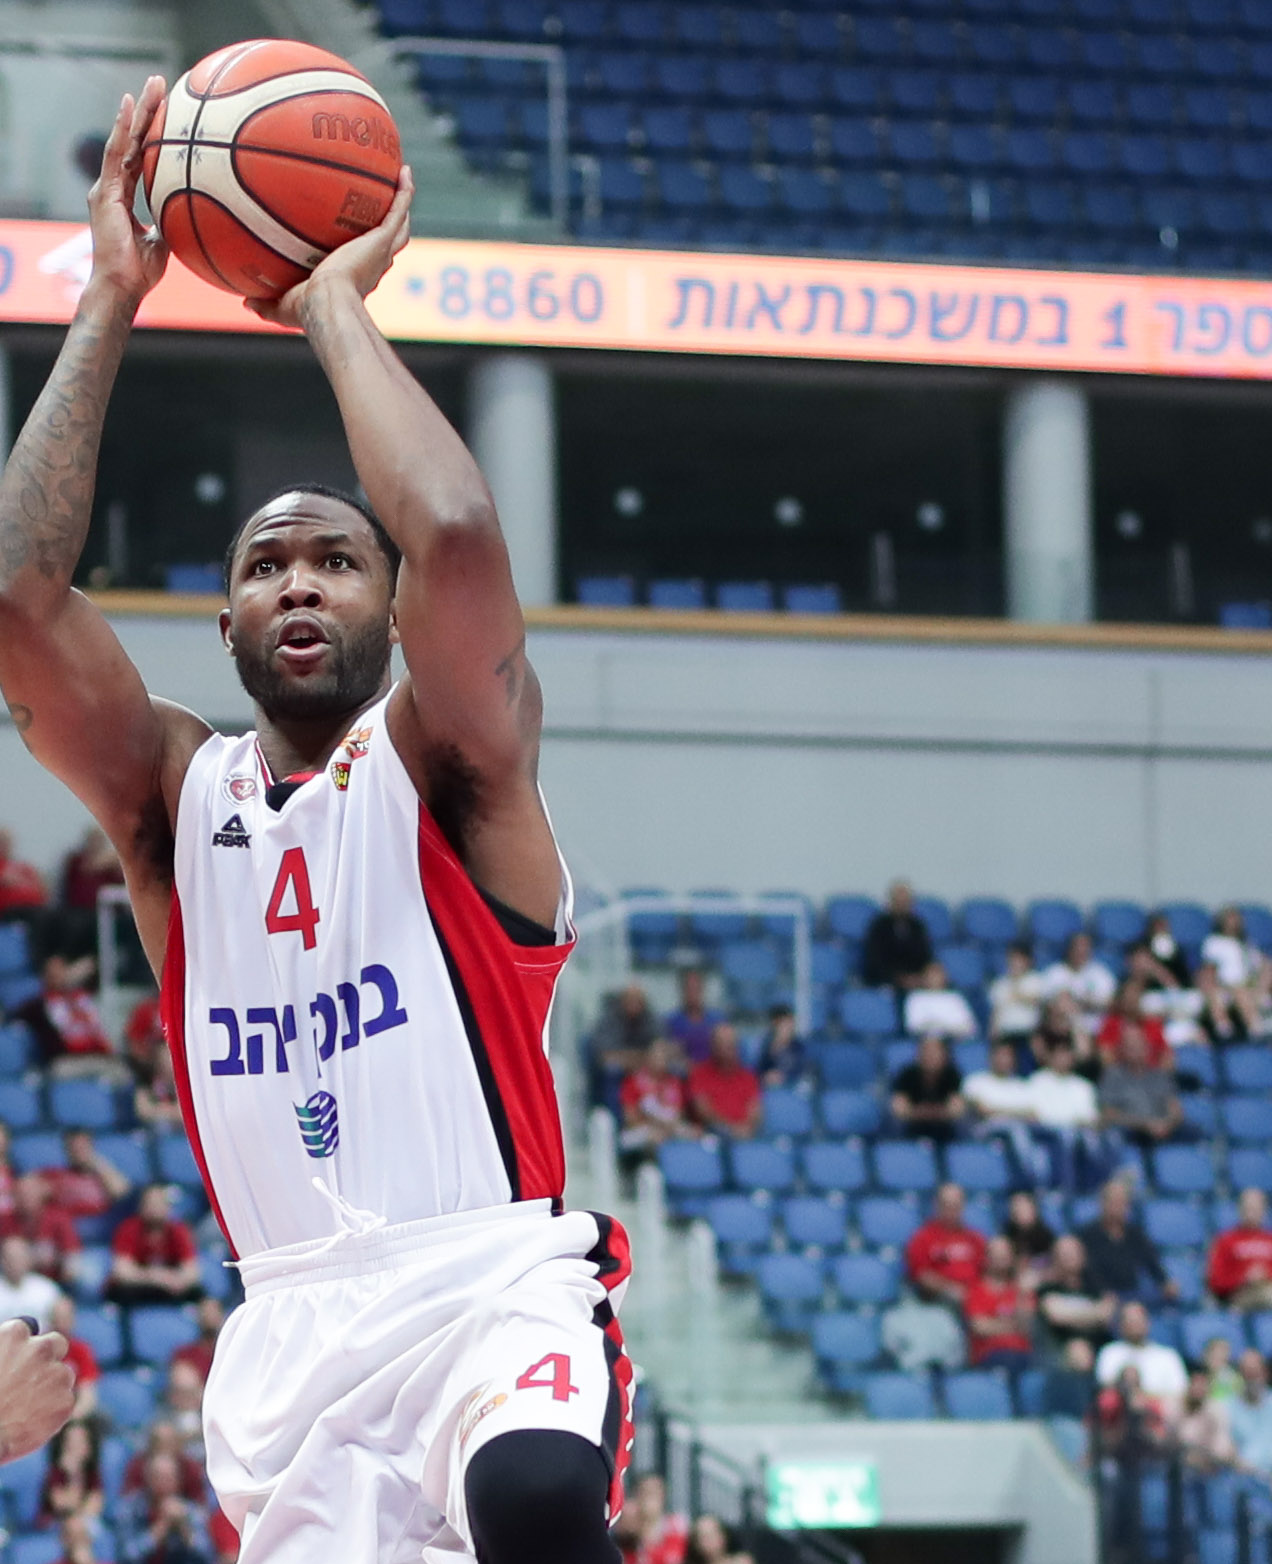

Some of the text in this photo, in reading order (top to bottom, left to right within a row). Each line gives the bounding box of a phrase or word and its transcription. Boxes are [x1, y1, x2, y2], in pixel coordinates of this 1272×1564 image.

[668, 276, 1070, 347] במשכנתאות
[1102, 300, 1128, 349] 1
[265, 846, 320, 951] 4
[209, 963, 409, 1079] בנק יהב
[515, 1352, 580, 1403] 4
